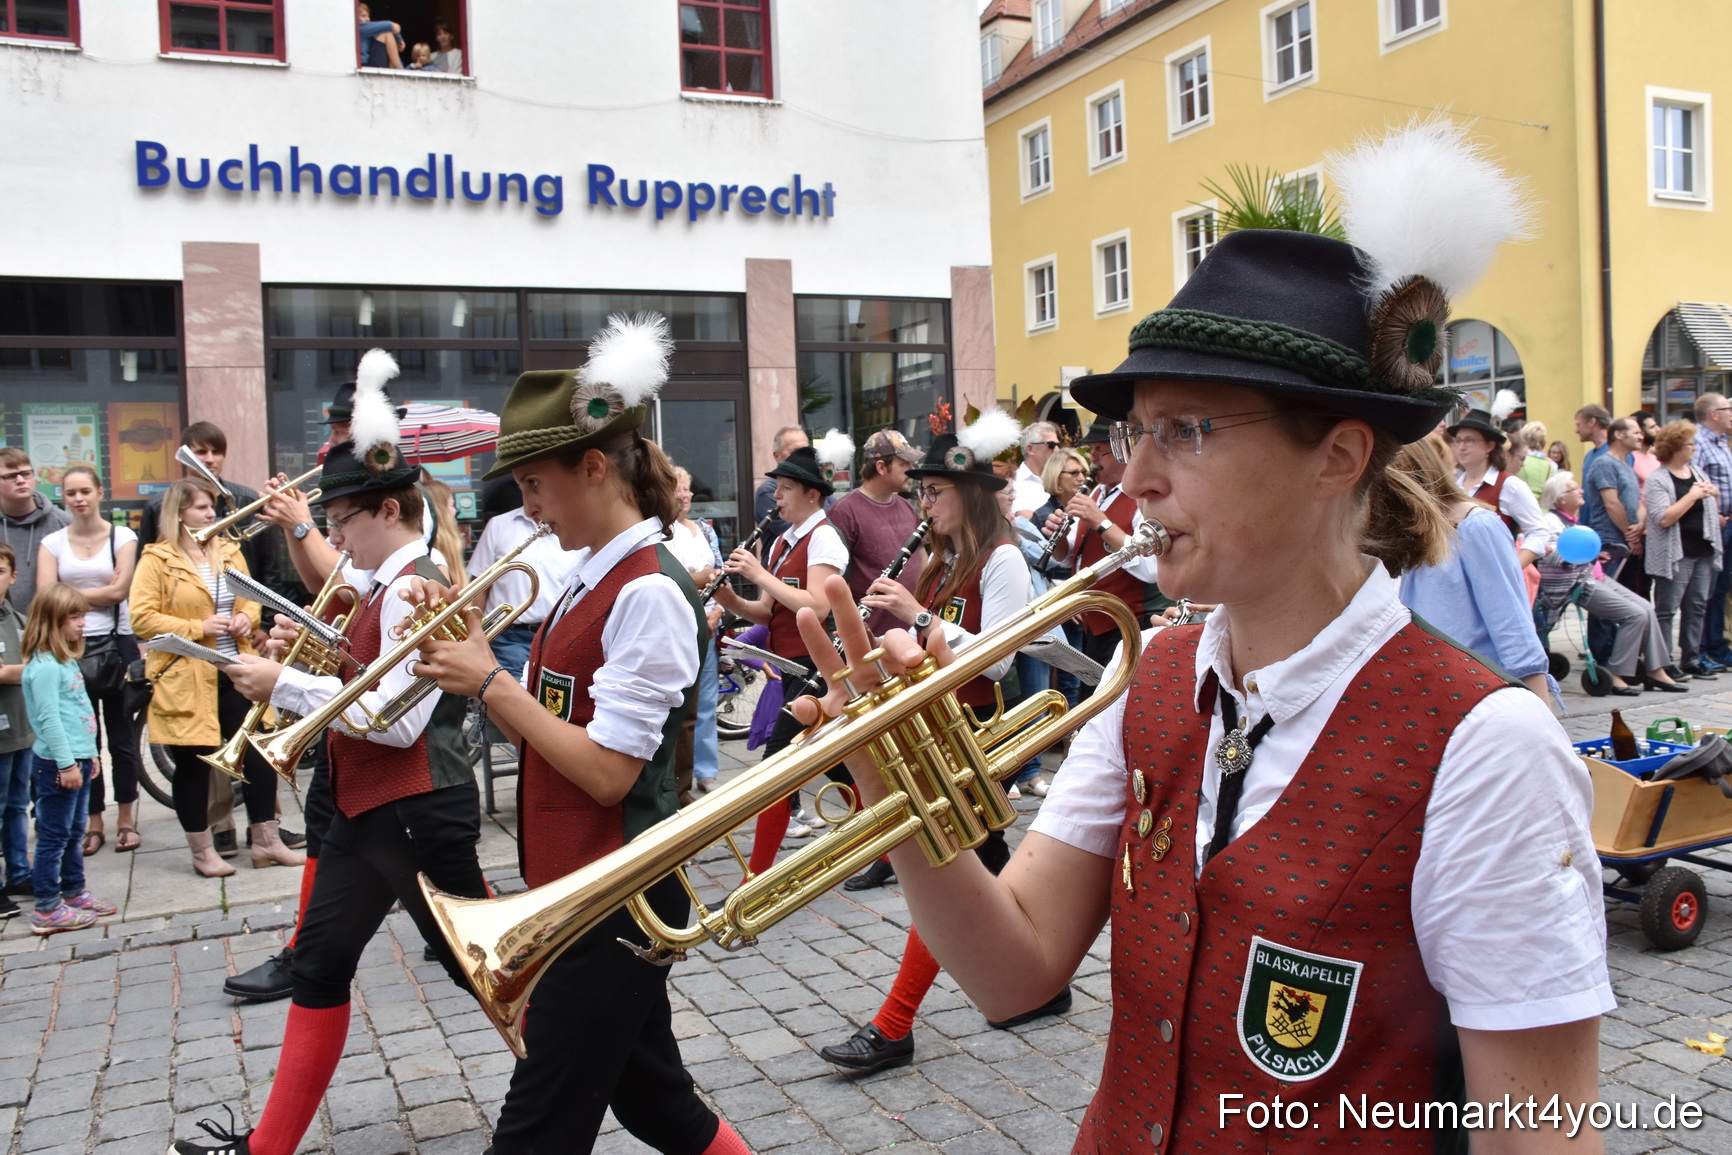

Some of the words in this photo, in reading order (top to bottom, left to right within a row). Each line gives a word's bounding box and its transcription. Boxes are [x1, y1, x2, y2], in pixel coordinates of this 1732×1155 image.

[135, 140, 563, 216] Buchhandlung
[587, 163, 837, 222] Rupprecht
[1256, 950, 1352, 986] BLASKAPELLE
[1247, 1033, 1325, 1074] PILSACH
